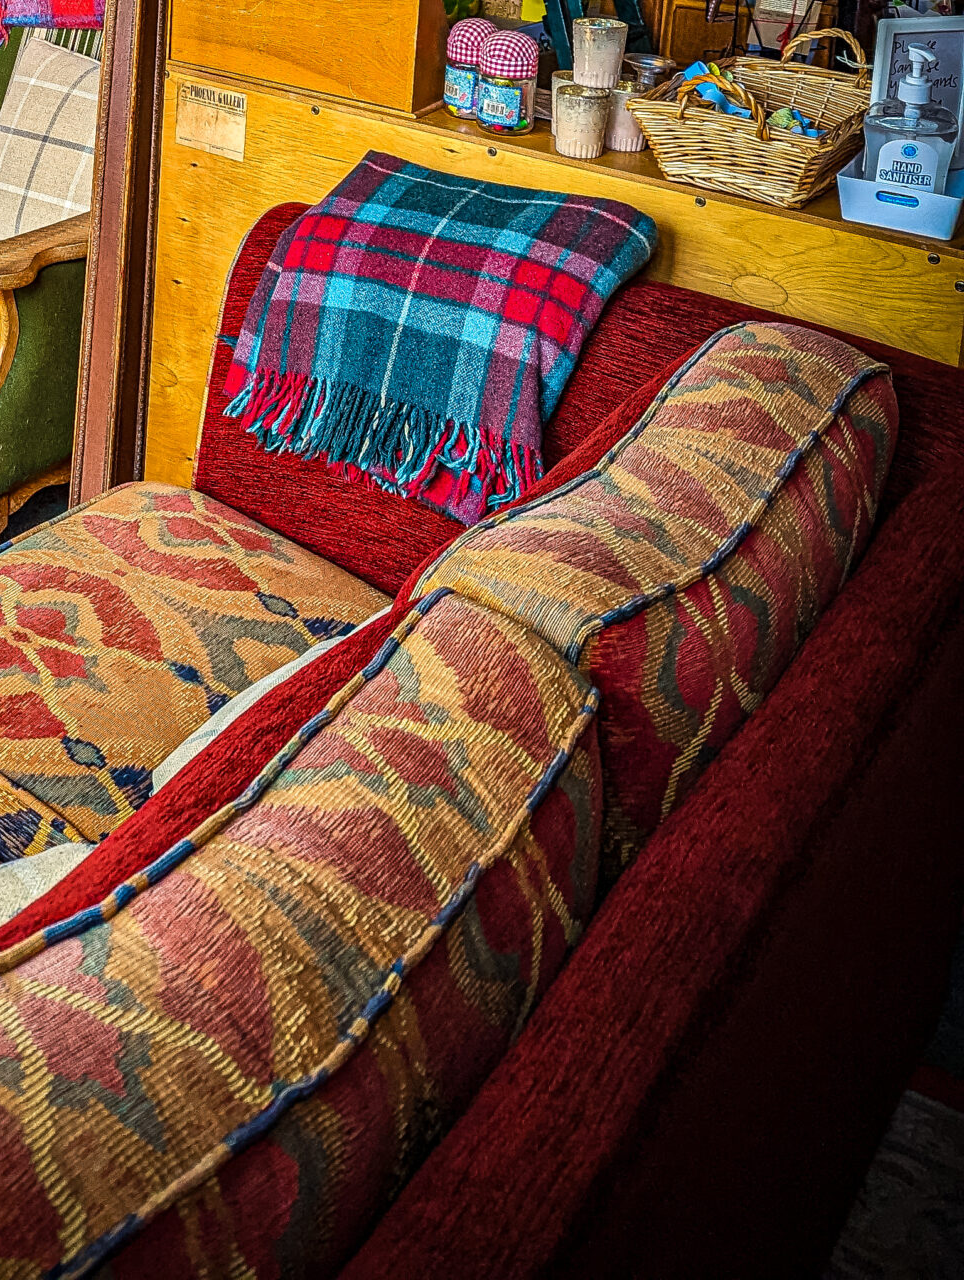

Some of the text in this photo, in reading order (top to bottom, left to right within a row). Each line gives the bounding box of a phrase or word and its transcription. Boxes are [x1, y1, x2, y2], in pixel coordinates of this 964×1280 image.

[190, 83, 216, 102] PHOENIX
[217, 91, 246, 111] GALLERY
[893, 161, 922, 174] HAND
[879, 169, 932, 186] SANITISER
